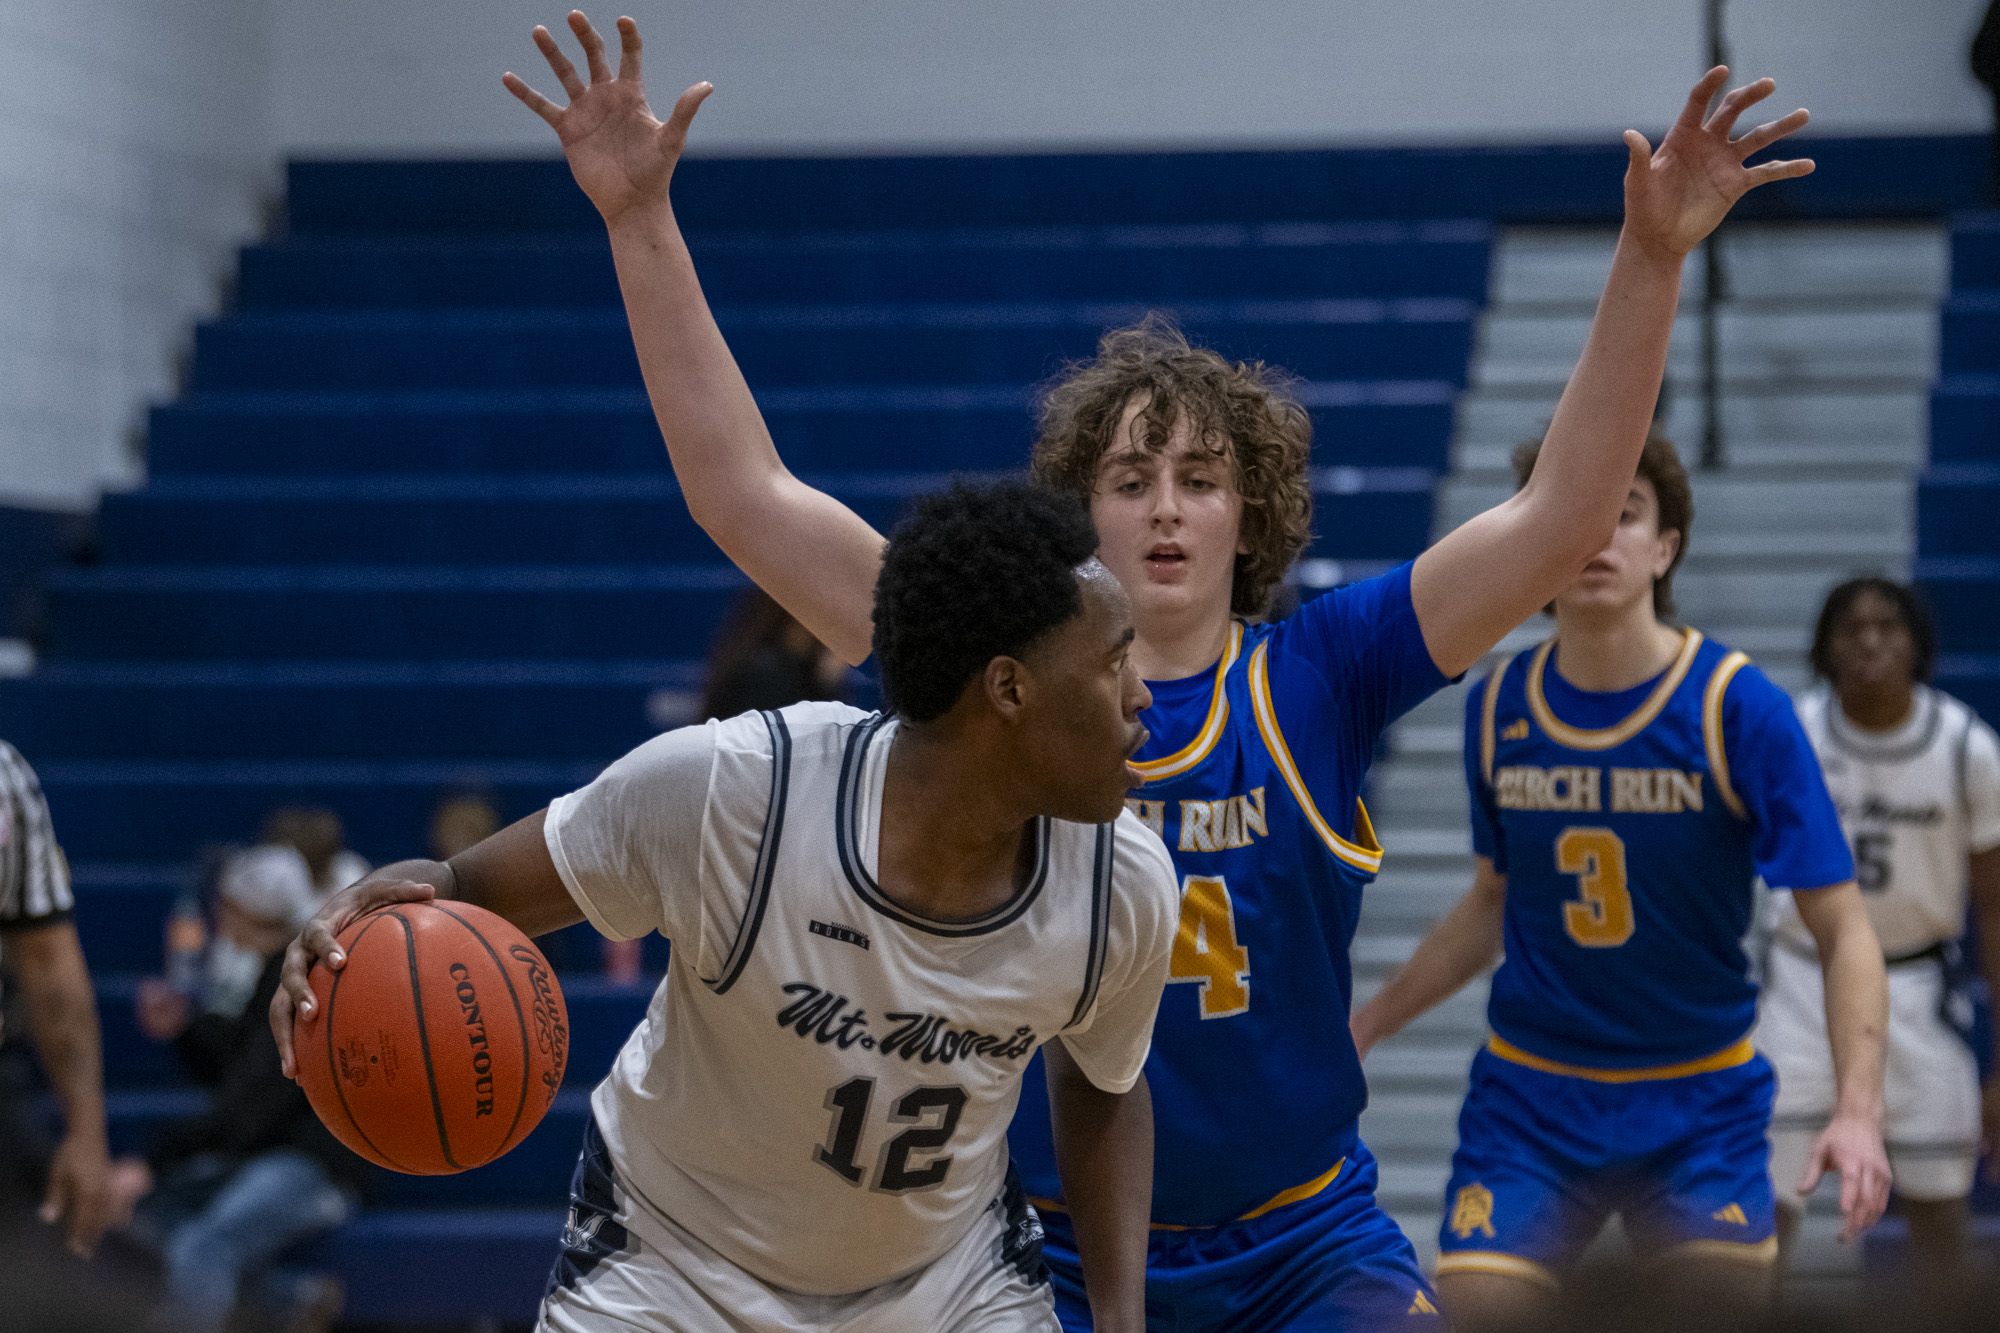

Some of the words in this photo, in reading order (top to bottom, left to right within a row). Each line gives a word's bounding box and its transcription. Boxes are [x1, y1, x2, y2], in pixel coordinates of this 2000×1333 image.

[1178, 786, 1269, 852] RUN
[1610, 766, 1703, 813] RUN
[1166, 875, 1250, 1020] 4
[1555, 825, 1635, 948] 3
[449, 962, 494, 1120] CONTOUR
[510, 944, 567, 1106] Rawlings
[776, 981, 877, 1050] Mt.
[811, 1075, 971, 1197] 12
